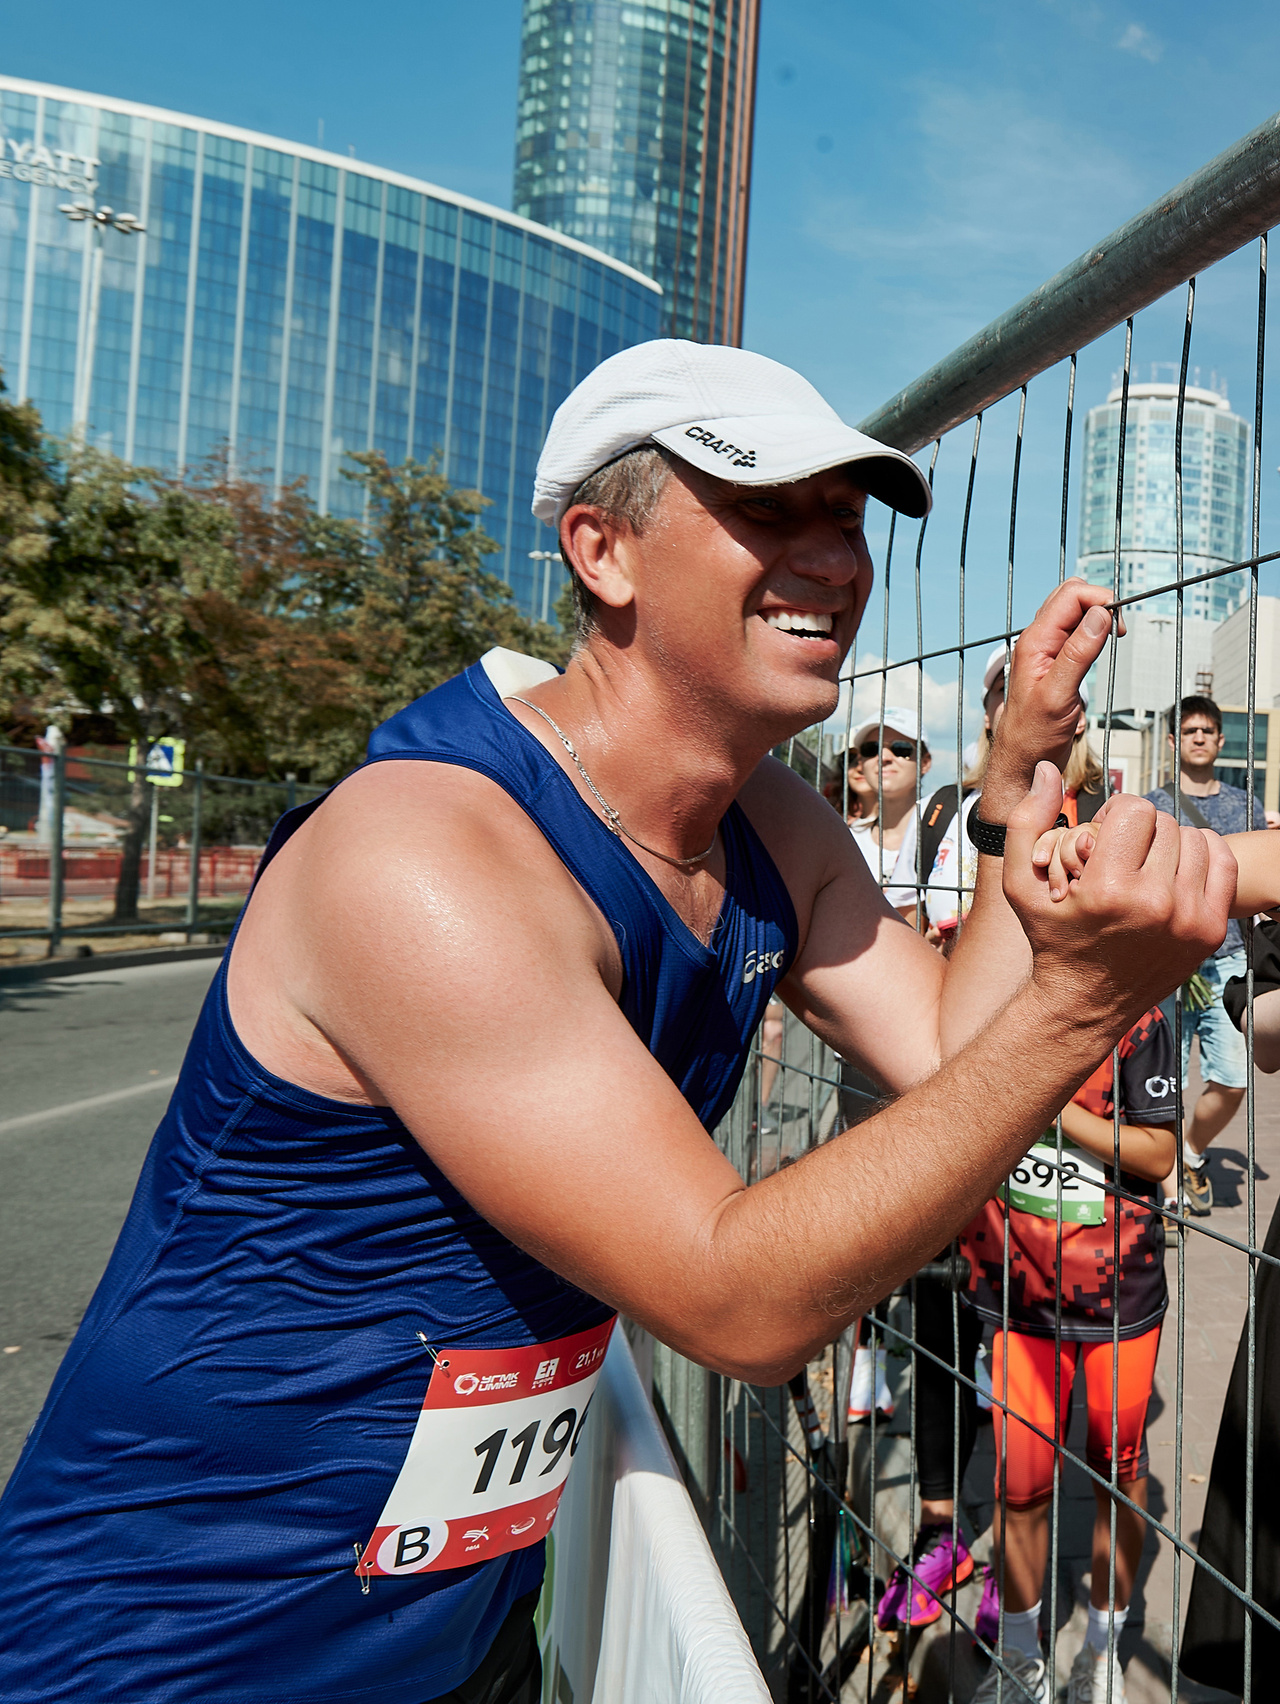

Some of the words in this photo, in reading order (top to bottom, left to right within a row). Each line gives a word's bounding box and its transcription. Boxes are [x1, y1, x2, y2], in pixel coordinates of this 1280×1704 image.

[0, 137, 101, 180] YATT
[0, 160, 99, 195] EGENCY
[685, 426, 743, 459] CRAFT
[393, 1526, 431, 1568] B
